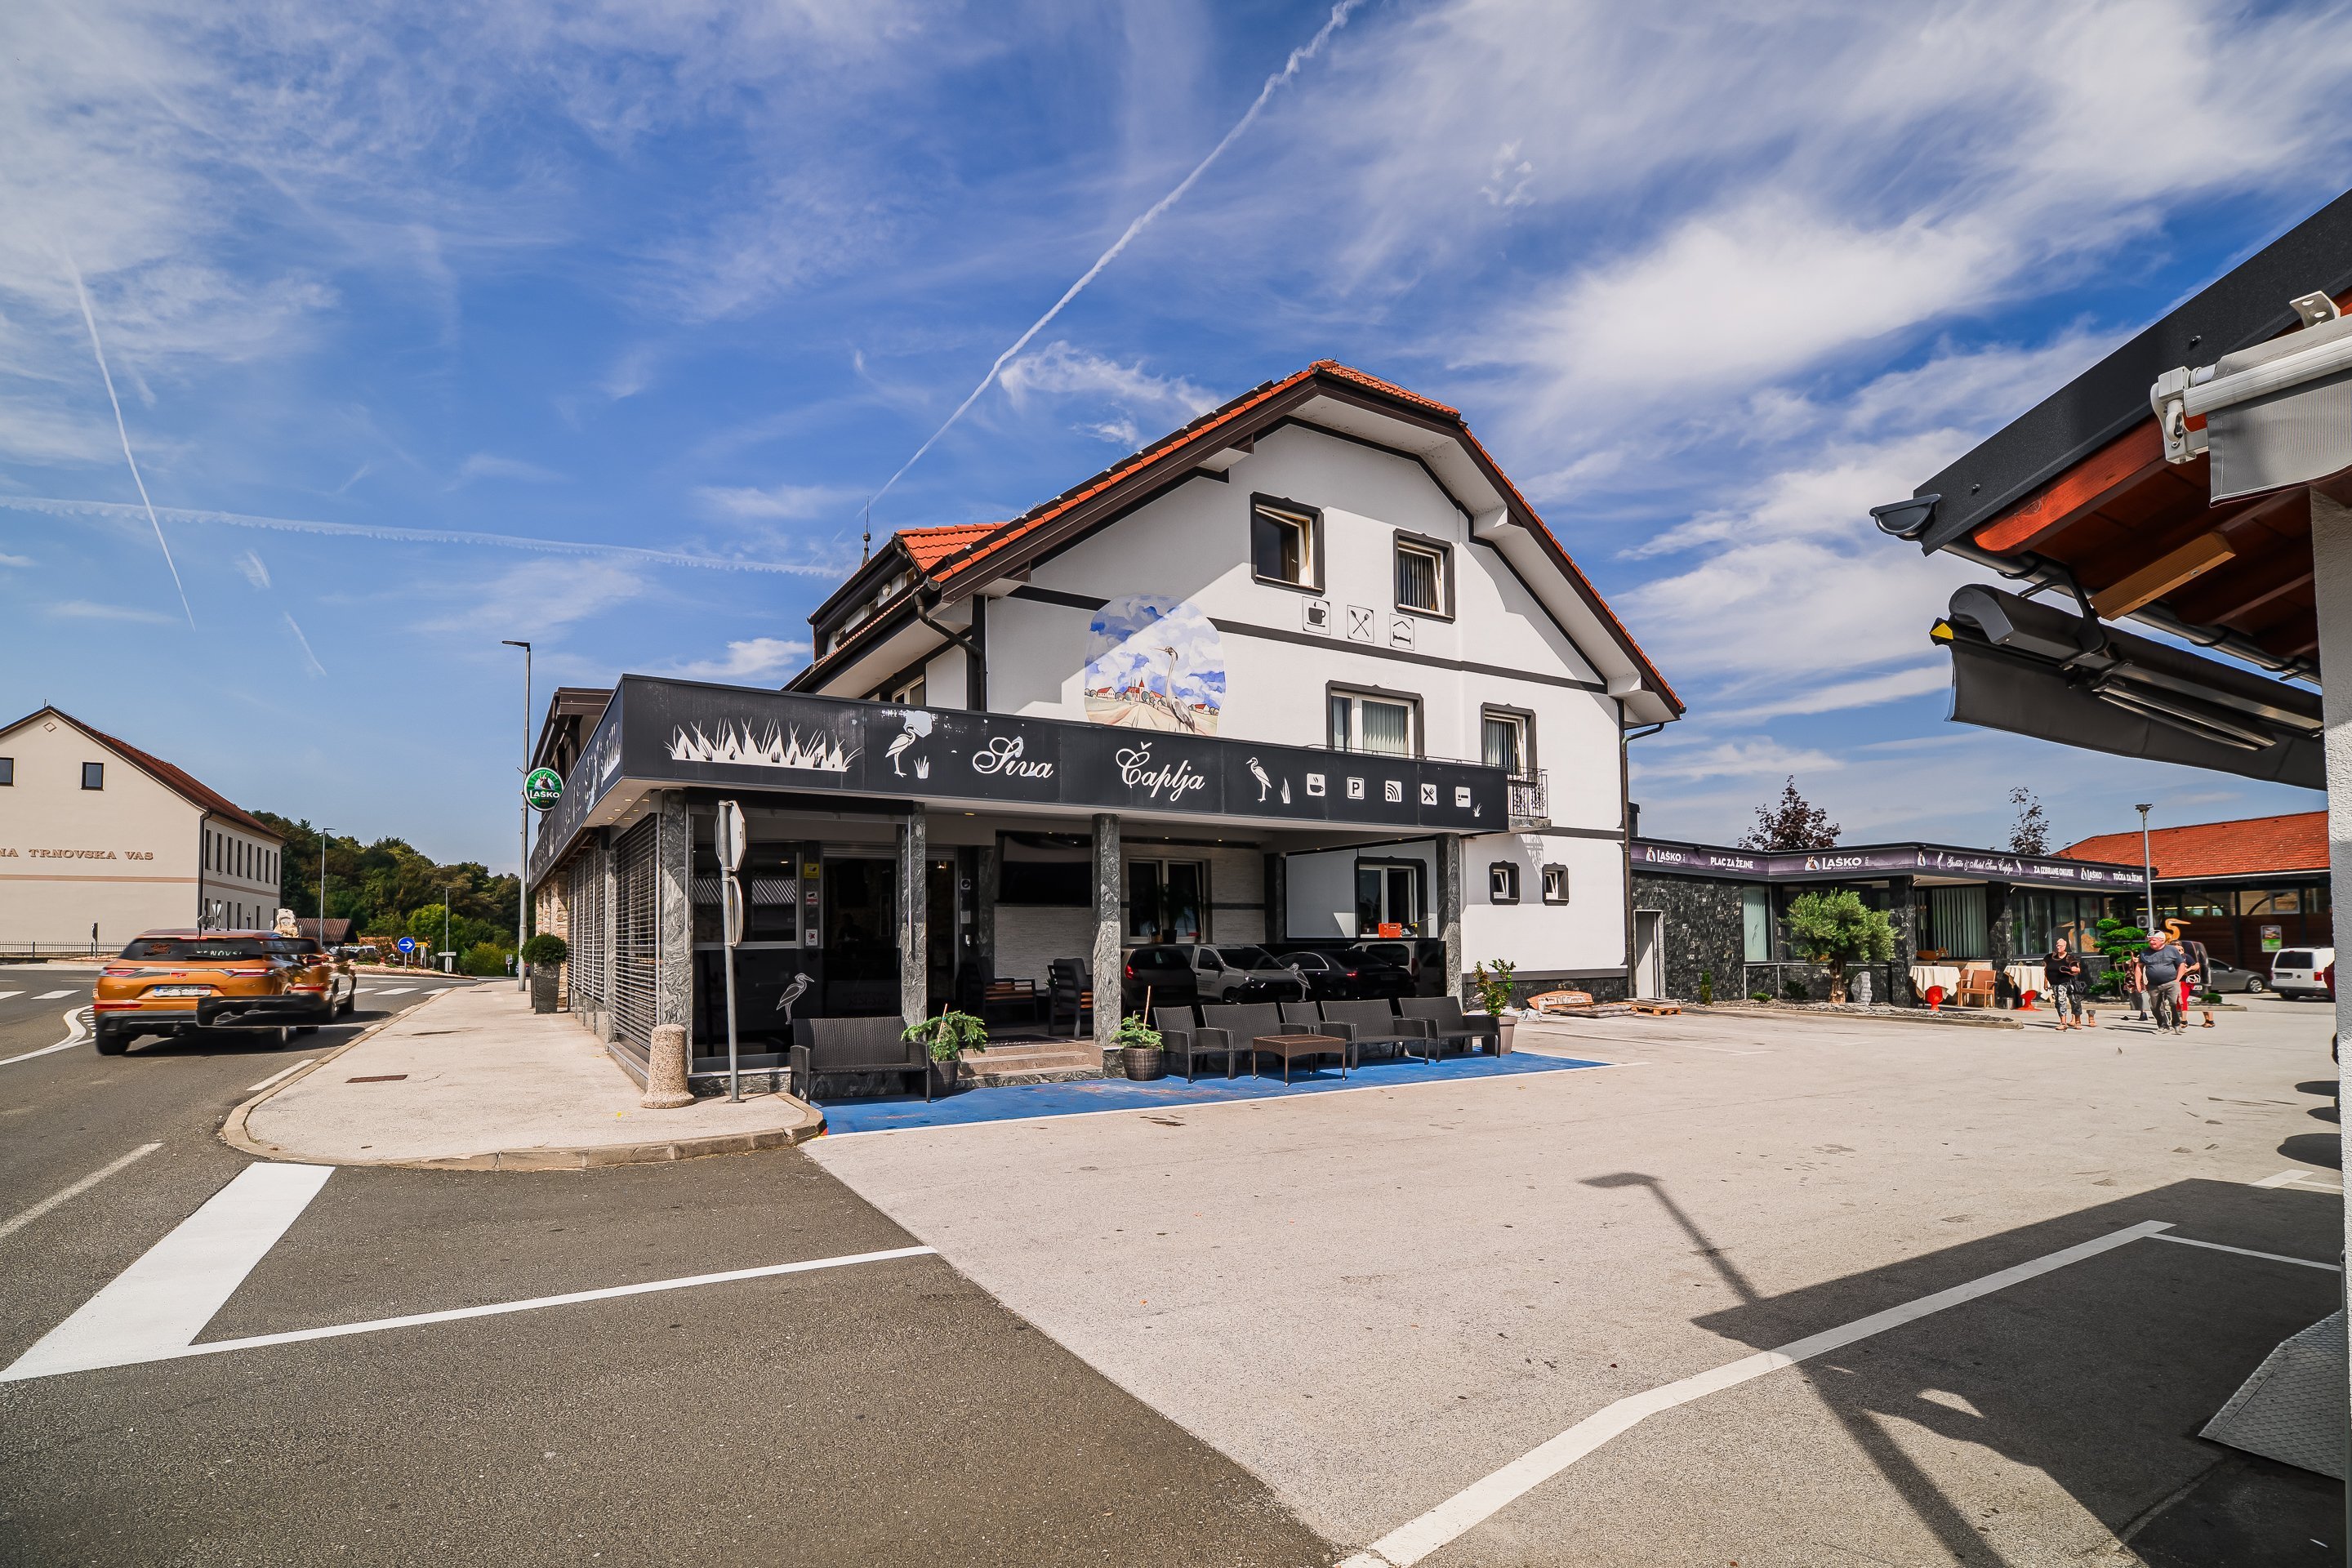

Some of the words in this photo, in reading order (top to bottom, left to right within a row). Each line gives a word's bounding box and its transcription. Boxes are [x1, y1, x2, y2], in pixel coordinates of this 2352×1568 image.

[972, 737, 1054, 778] Siva
[1116, 741, 1205, 802] Čaplja
[29, 849, 118, 860] TRNOVSKA
[125, 851, 154, 861] VAS
[1657, 849, 1682, 863] LAŠKO
[1710, 857, 1726, 866] PLAC
[1726, 858, 1735, 868] ZA
[1822, 856, 1862, 871] LAŠKO
